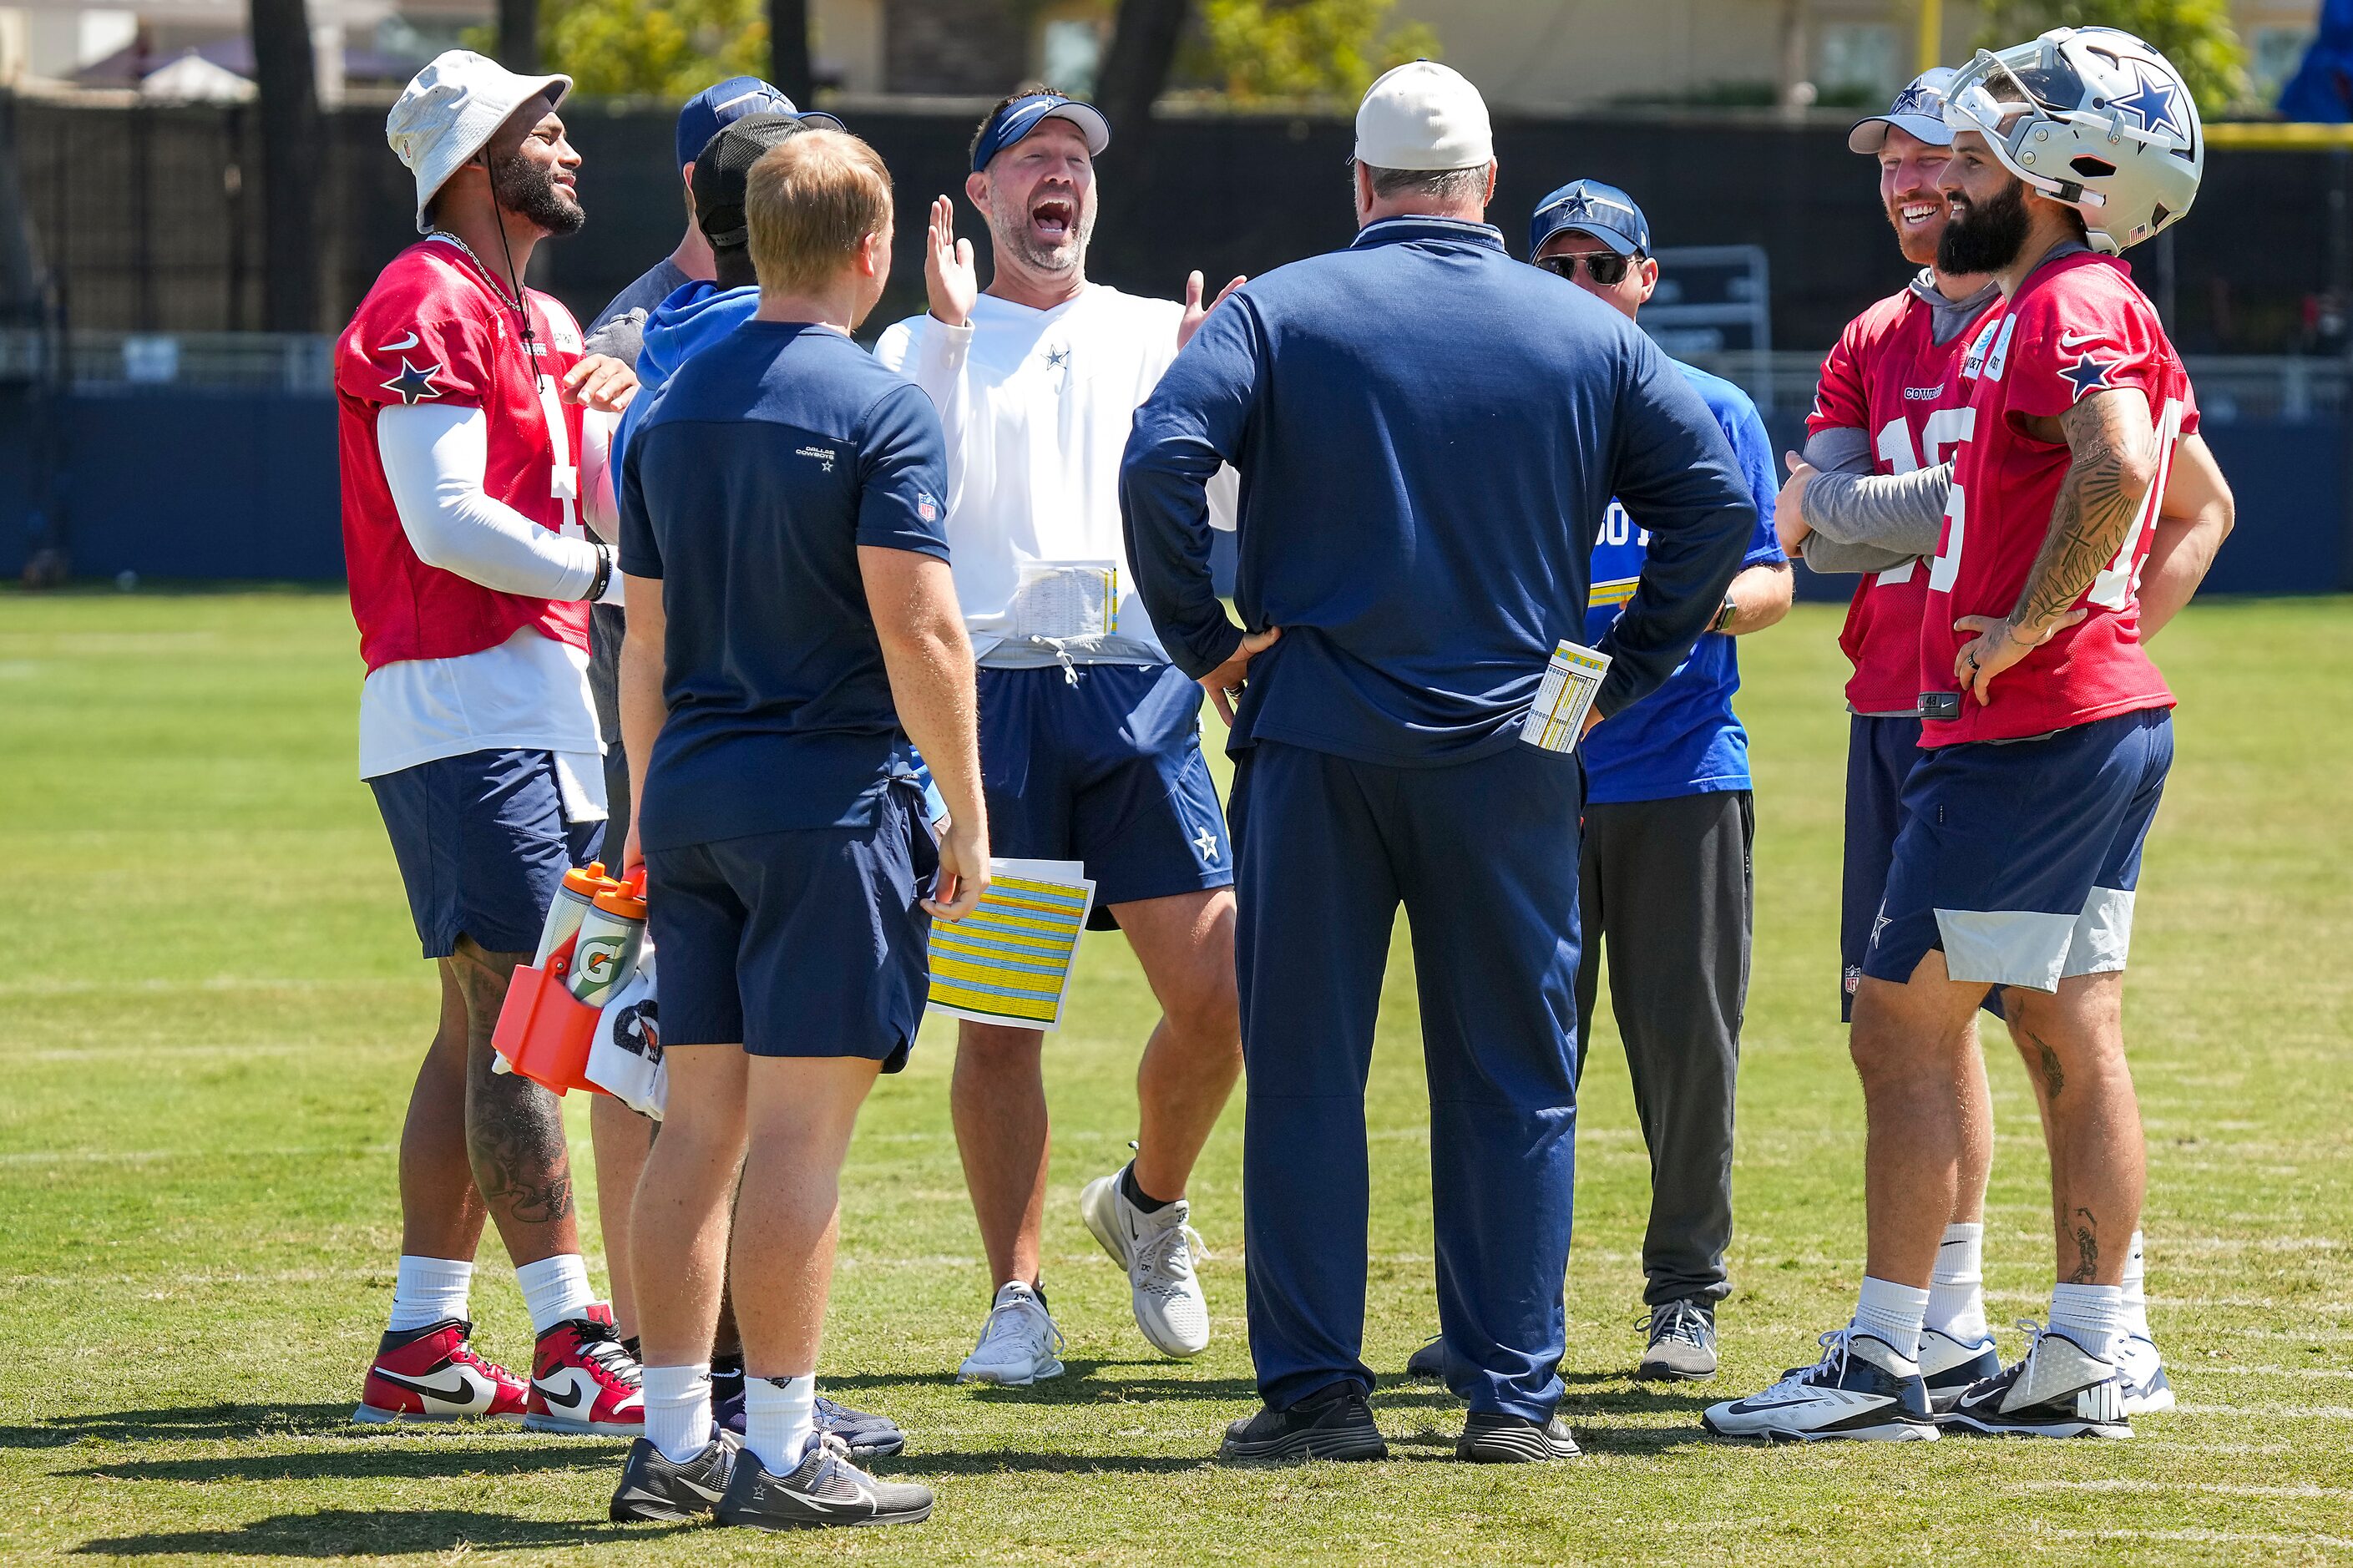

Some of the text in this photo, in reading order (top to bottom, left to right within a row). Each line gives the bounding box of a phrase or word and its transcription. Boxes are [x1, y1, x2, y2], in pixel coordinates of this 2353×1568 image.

[795, 448, 835, 460] COWBOYS
[805, 446, 835, 455] DALLAS
[921, 503, 935, 518] NFL
[579, 942, 618, 984] G
[2077, 1380, 2128, 1422] NIK
